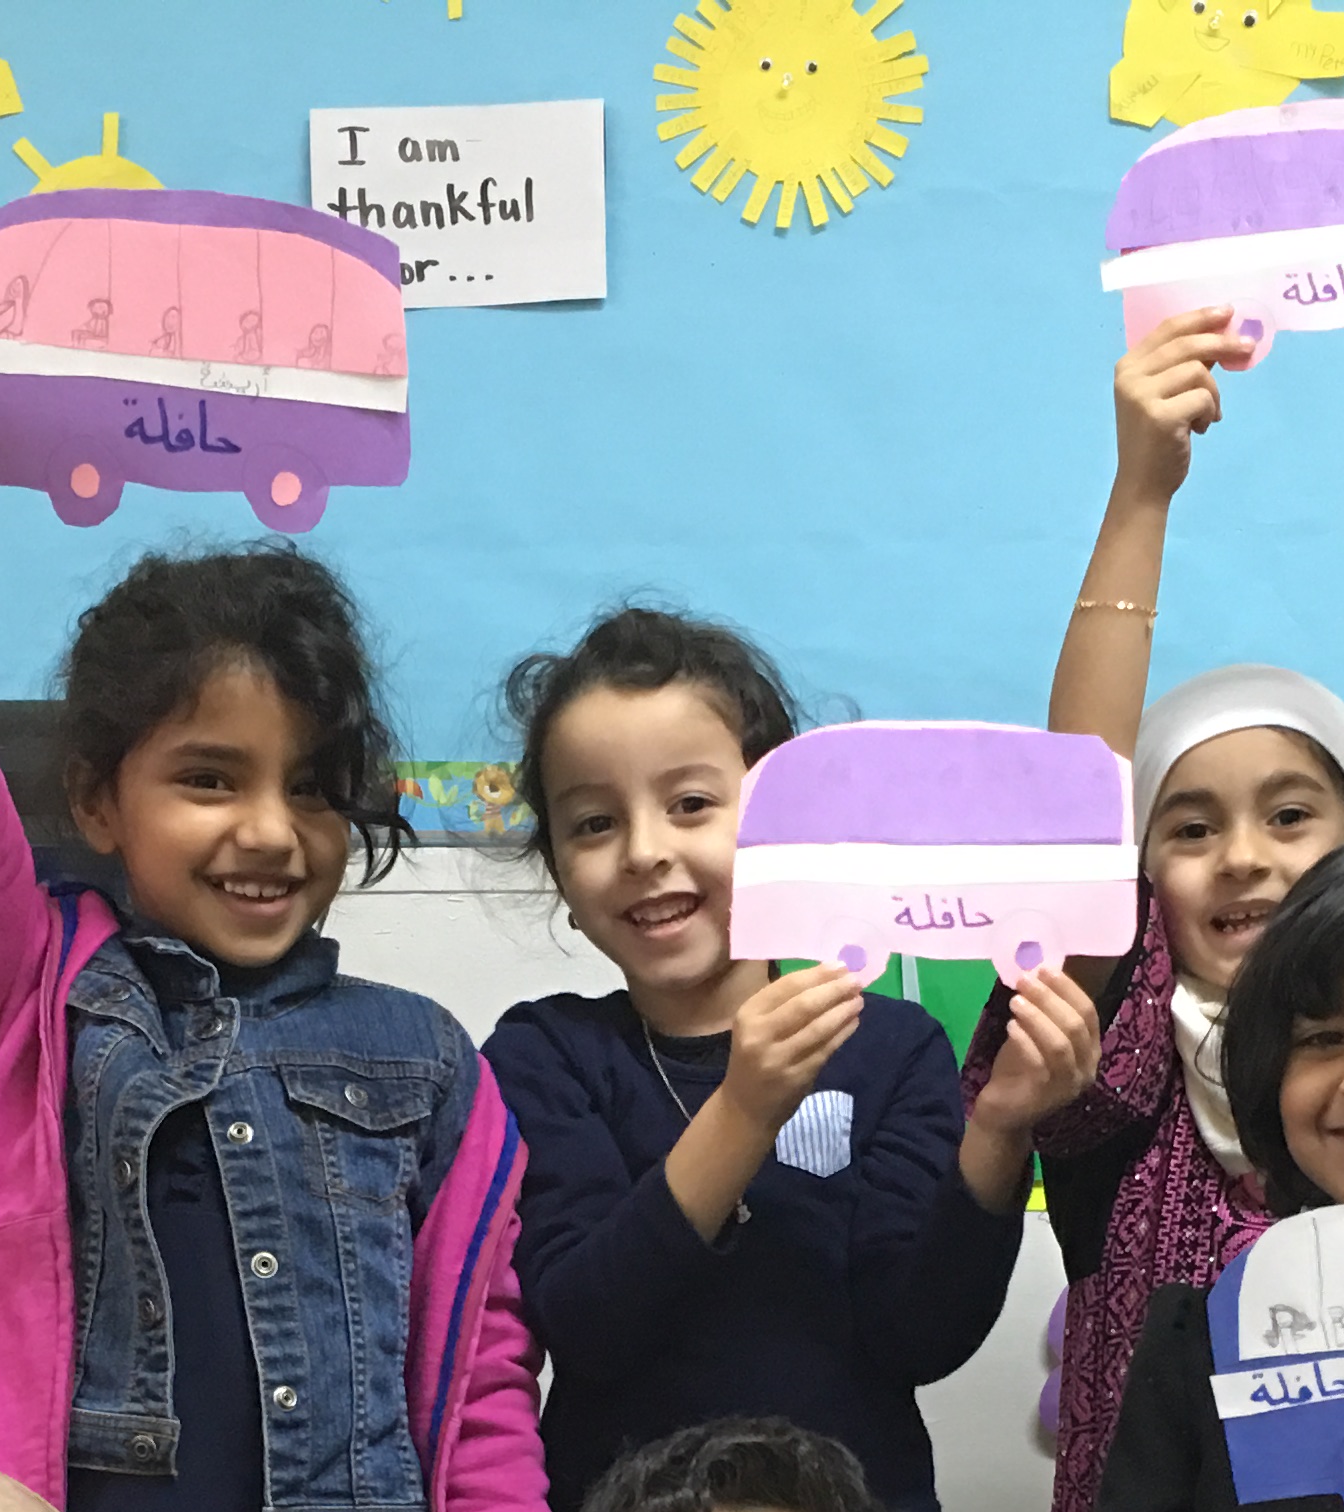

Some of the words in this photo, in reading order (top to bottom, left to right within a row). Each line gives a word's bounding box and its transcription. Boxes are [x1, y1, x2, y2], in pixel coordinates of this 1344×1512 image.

[337, 126, 370, 165] I
[398, 137, 460, 163] am
[327, 177, 534, 229] thankful
[400, 259, 494, 286] or...
[123, 398, 242, 454] حافلة
[892, 894, 994, 931] حافلة
